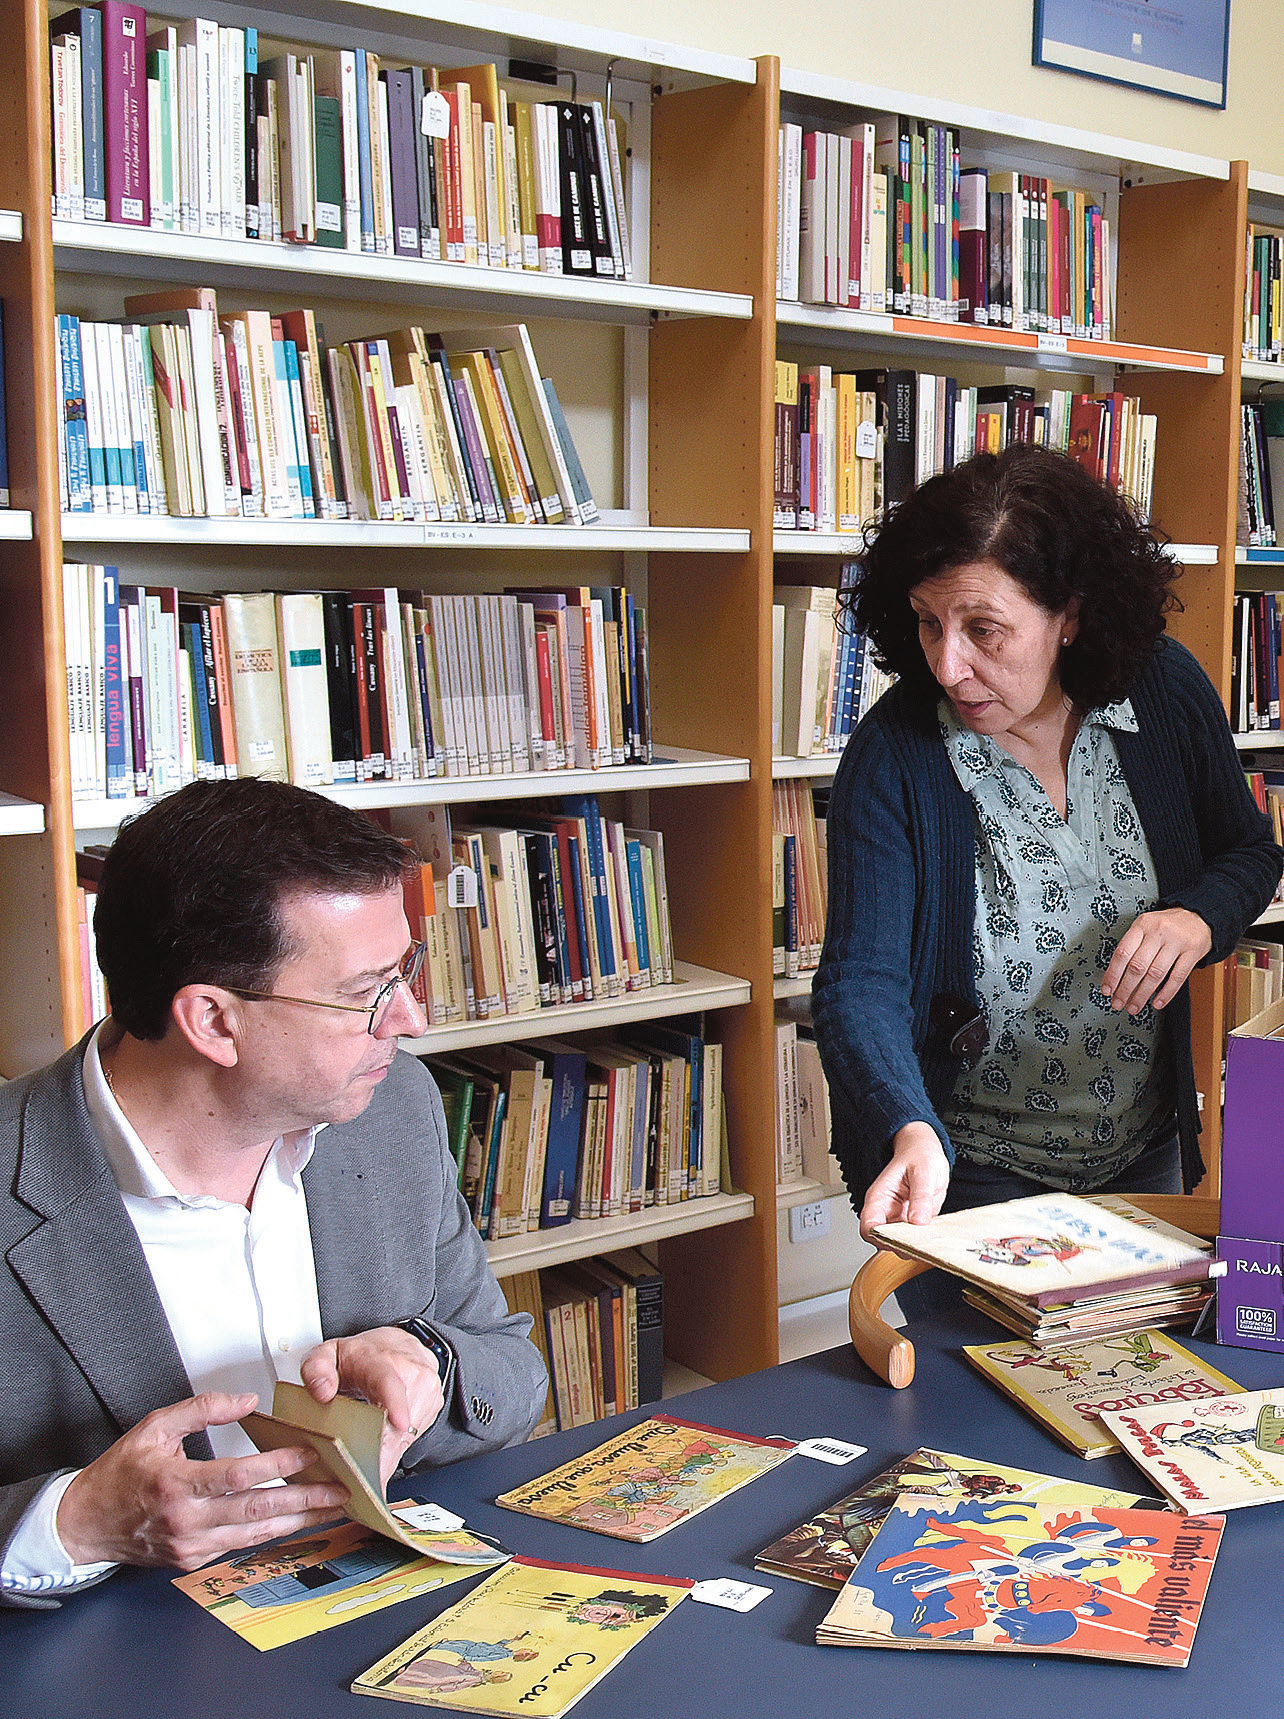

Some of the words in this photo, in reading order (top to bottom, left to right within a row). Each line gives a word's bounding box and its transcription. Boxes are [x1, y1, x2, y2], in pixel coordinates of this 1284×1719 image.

[122, 89, 130, 124] cortesanas
[232, 74, 242, 120] Twice-Told
[132, 115, 140, 132] siglo
[122, 125, 131, 154] facciones
[132, 144, 140, 169] España
[122, 161, 131, 196] Literatura
[133, 170, 139, 178] la
[133, 178, 139, 187] en
[896, 383, 904, 419] MISIONES
[902, 385, 911, 438] PEDAGÓGICAS
[103, 577, 115, 605] 1
[201, 610, 211, 639] lapicero
[105, 644, 119, 681] viva
[203, 648, 214, 668] Afilar
[207, 676, 217, 705] Cassany
[368, 663, 377, 692] Cassany
[106, 689, 123, 748] lengua
[1236, 1259, 1283, 1277] RAJA
[1239, 1308, 1273, 1323] 100%
[1239, 1319, 1273, 1328] SATISFACTION
[1239, 1324, 1273, 1333] GUARANTEED
[638, 1423, 679, 1442] Que
[564, 1462, 593, 1479] que
[1181, 1518, 1221, 1531] el
[1166, 1534, 1215, 1572] más
[1145, 1576, 1203, 1648] valiente
